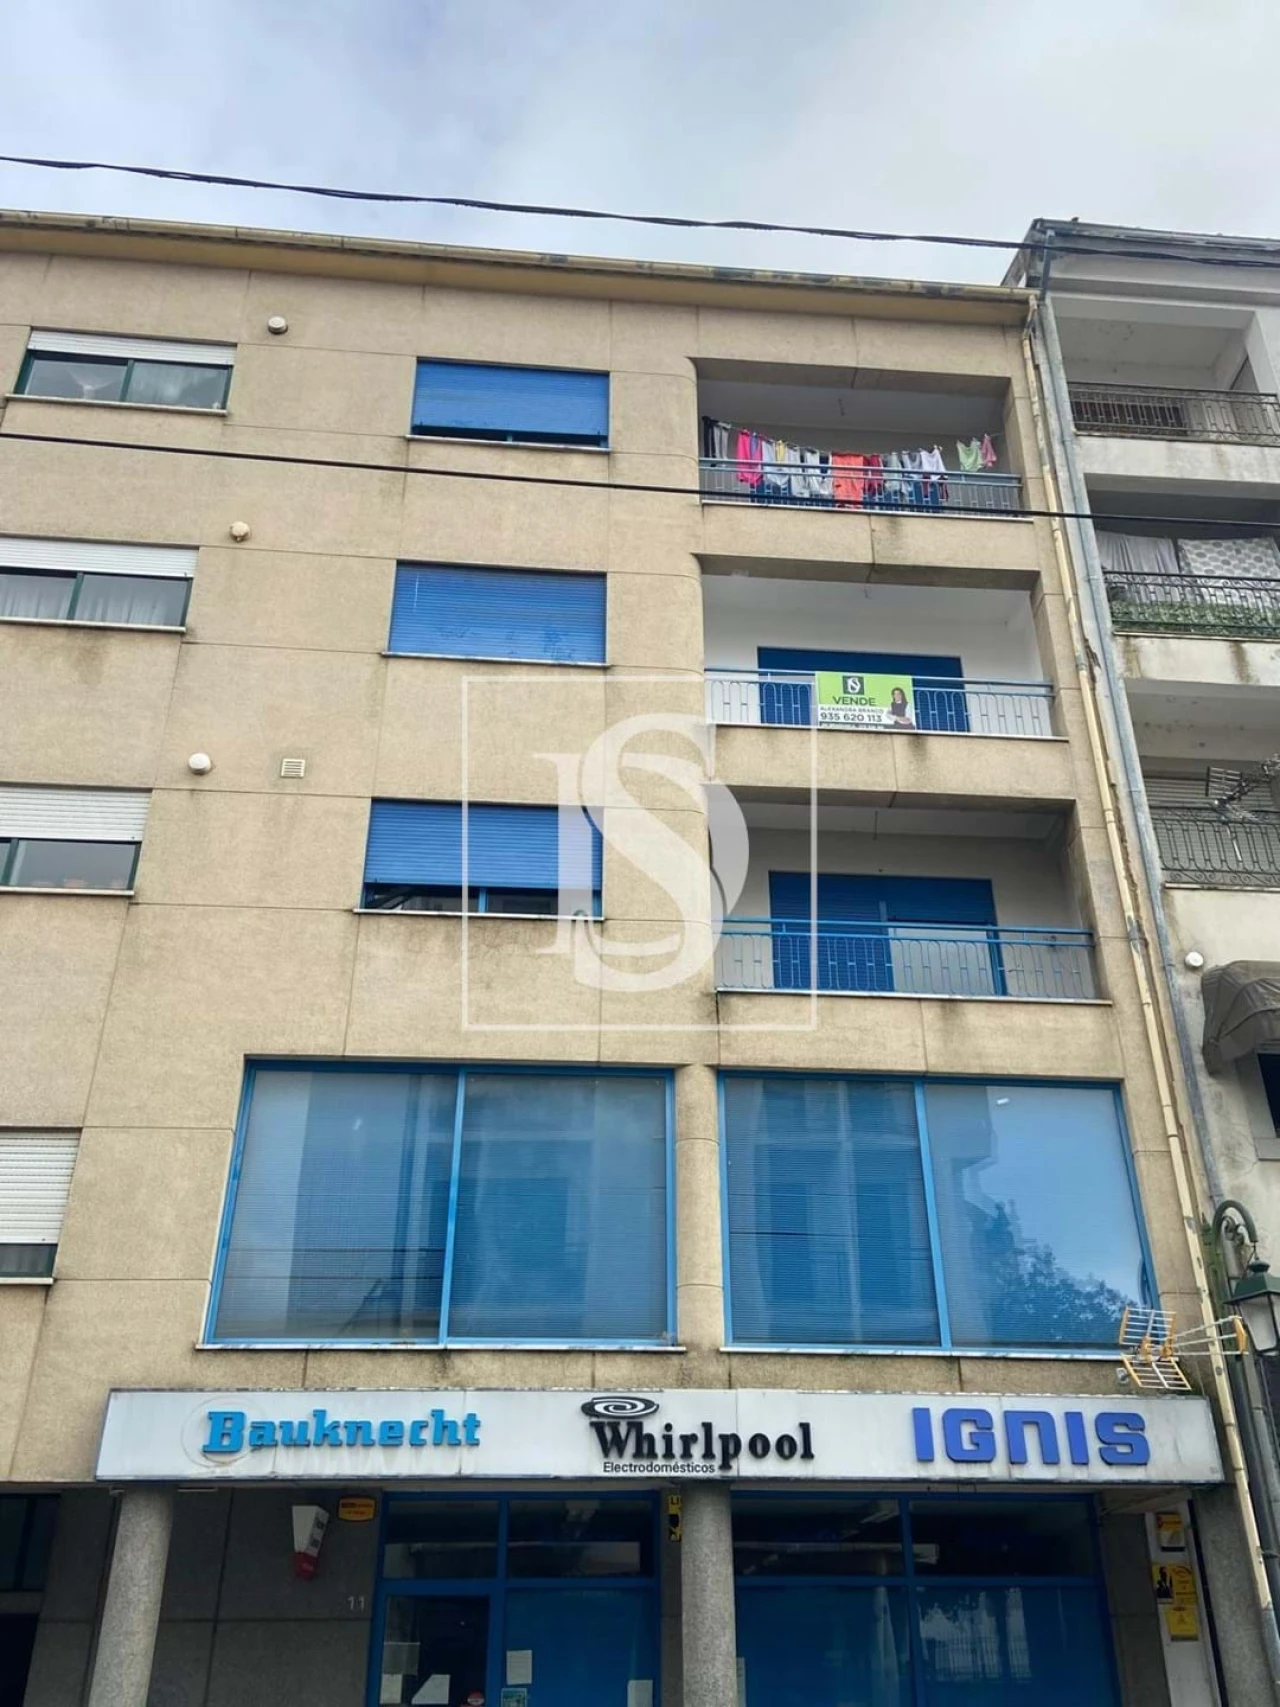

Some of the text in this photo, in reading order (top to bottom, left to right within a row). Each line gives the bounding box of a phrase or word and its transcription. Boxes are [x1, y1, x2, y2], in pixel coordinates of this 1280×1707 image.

[832, 696, 877, 706] VENDE
[820, 712, 882, 722] 935 620 113
[202, 1409, 481, 1454] Bauknecht
[589, 1420, 815, 1470] Whirlpool
[602, 1461, 716, 1474] Electrodomésticos
[347, 1596, 365, 1612] 11
